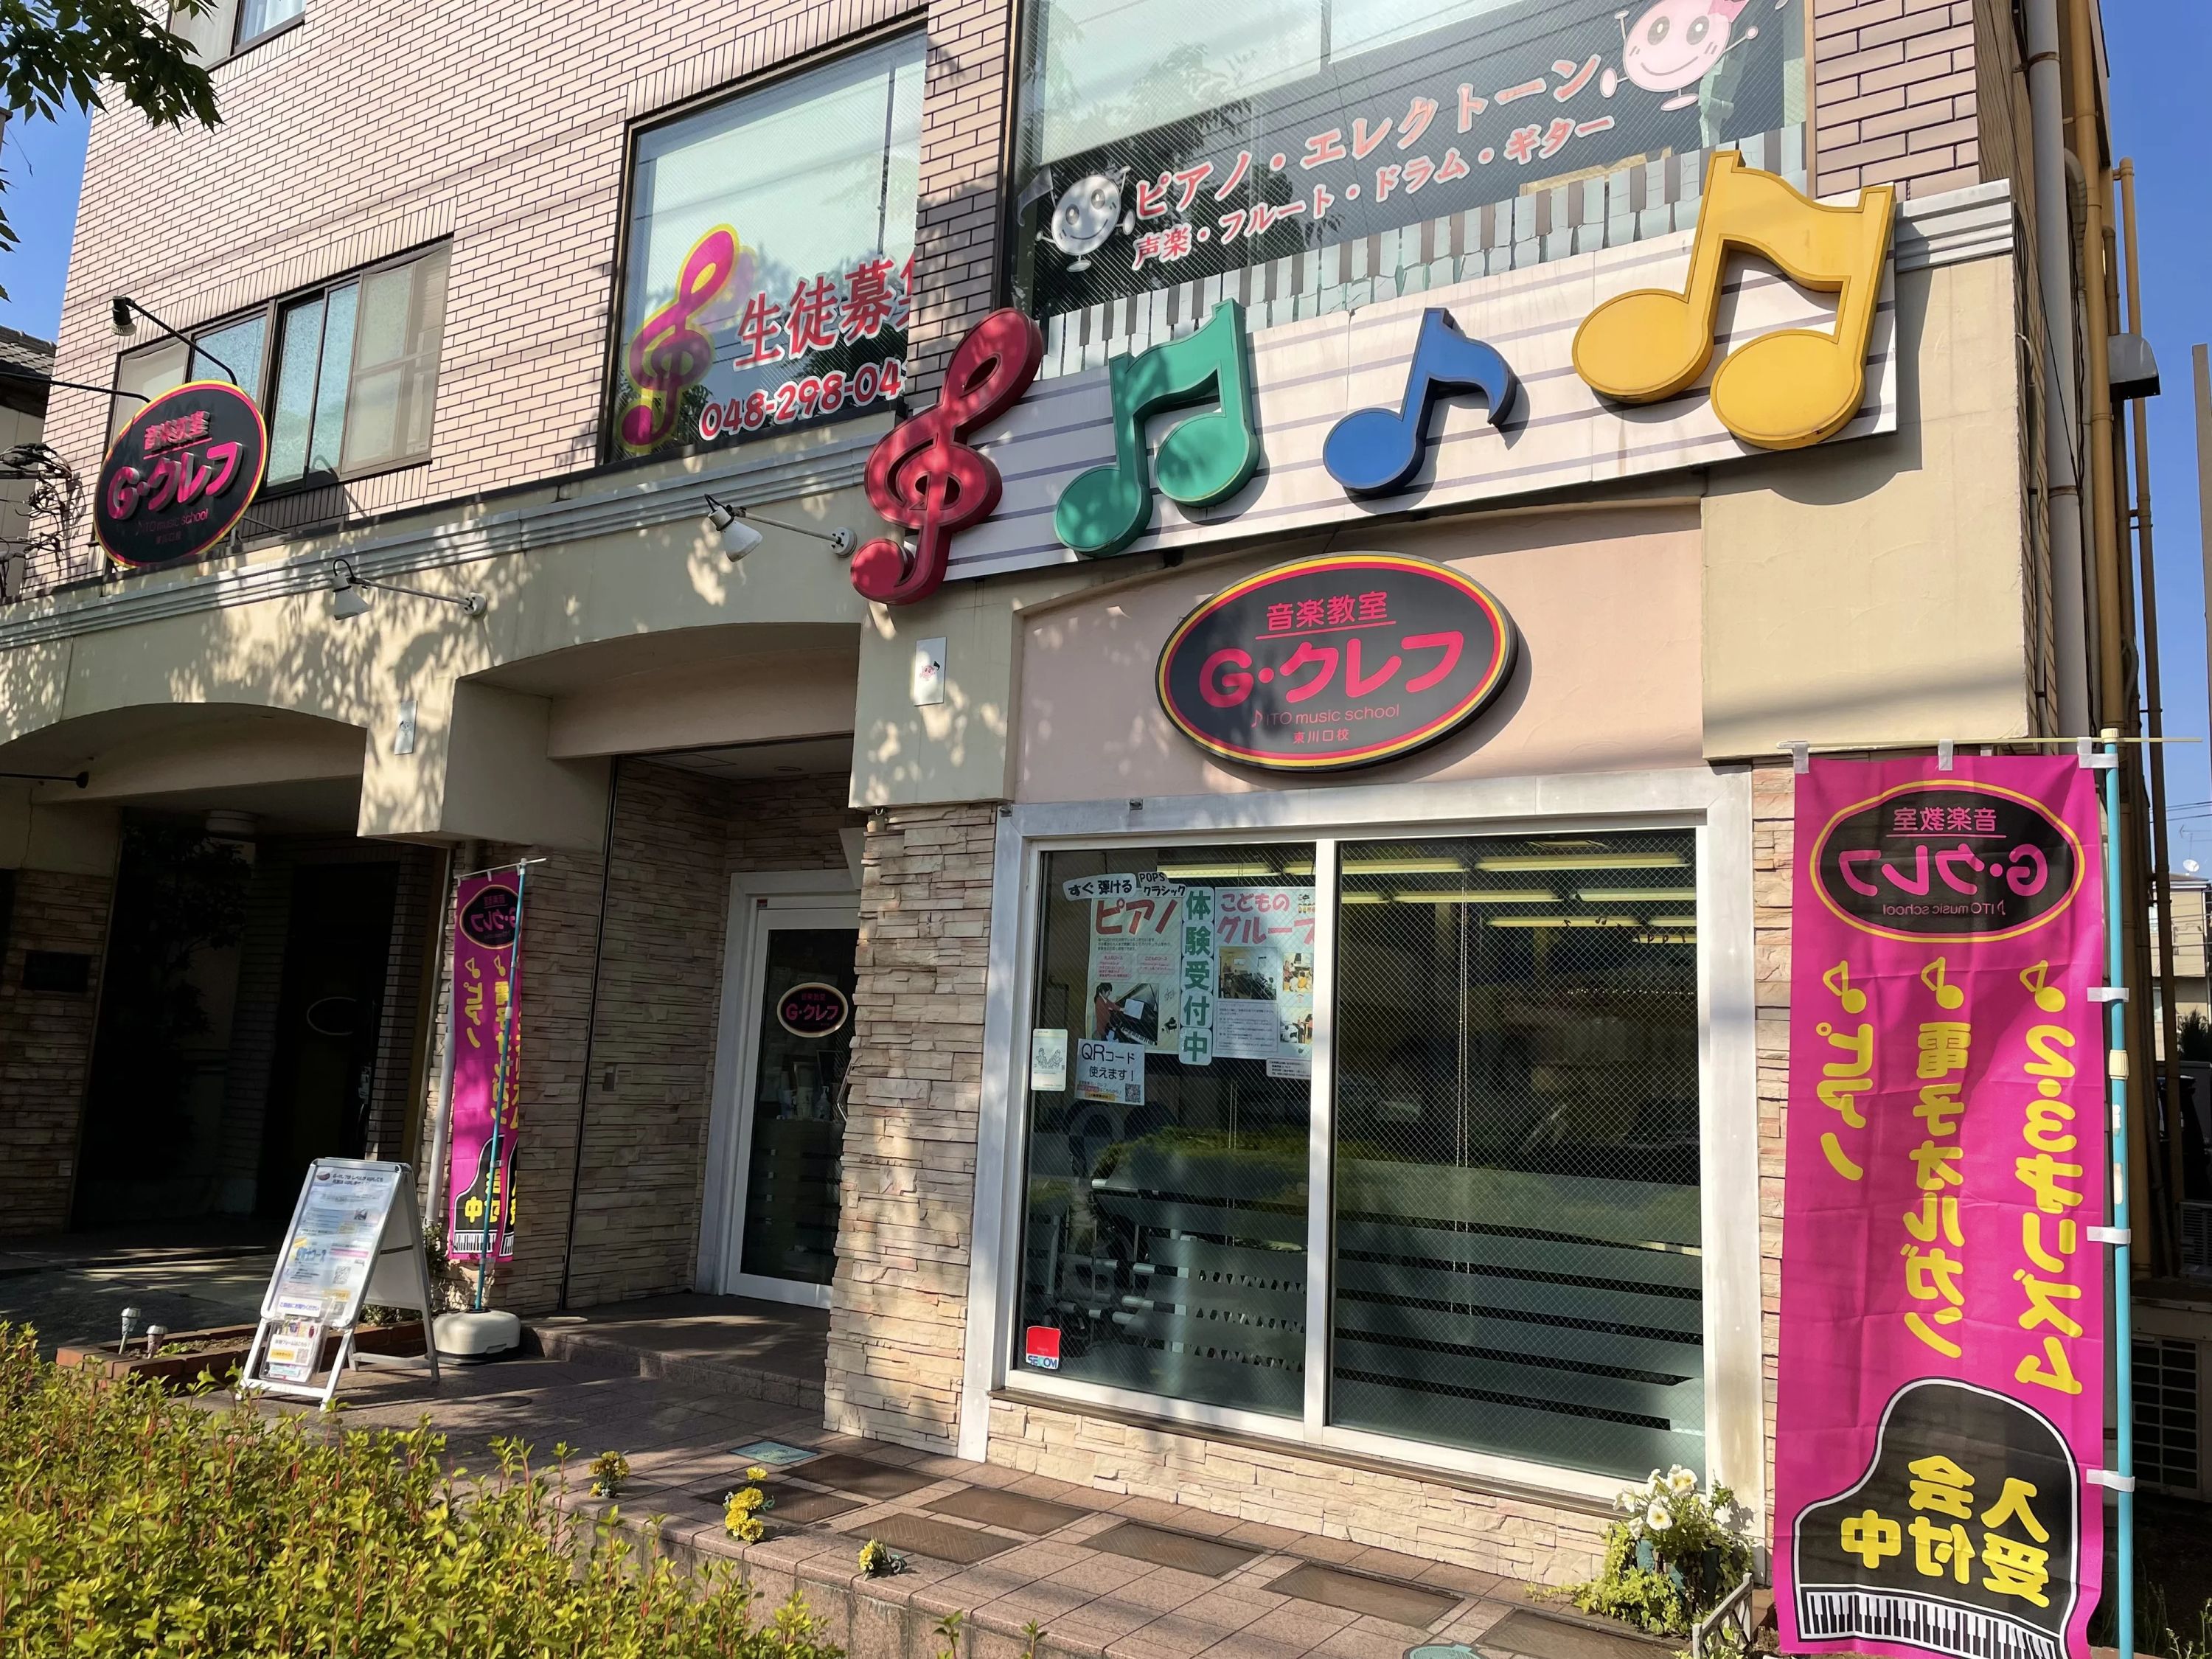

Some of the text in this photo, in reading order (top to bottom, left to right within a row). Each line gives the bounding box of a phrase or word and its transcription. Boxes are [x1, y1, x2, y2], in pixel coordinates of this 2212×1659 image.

[1135, 53, 1603, 221] ピアノ・エレクトーン
[1133, 115, 1615, 270] 声楽・フルート・ドラム・ギター
[699, 361, 908, 441] 048-298-04
[107, 442, 243, 520] G・クレフ
[181, 509, 209, 526] school
[1266, 590, 1388, 632] 音楽教室
[1199, 630, 1465, 709] G・クレフ
[1266, 703, 1400, 726] ITO music school
[1292, 728, 1350, 745] 東川口校
[1139, 872, 1166, 883] POPS
[1143, 883, 1186, 897] クラシック
[1220, 893, 1290, 913] こどもの
[1095, 899, 1178, 936] ピアノ
[1183, 890, 1214, 1063] 体験受付中
[785, 1004, 839, 1021] G・クレフ
[1081, 1043, 1135, 1065] QRコード
[1089, 1065, 1134, 1082] 使えます！
[1028, 1355, 1058, 1368] SECOM
